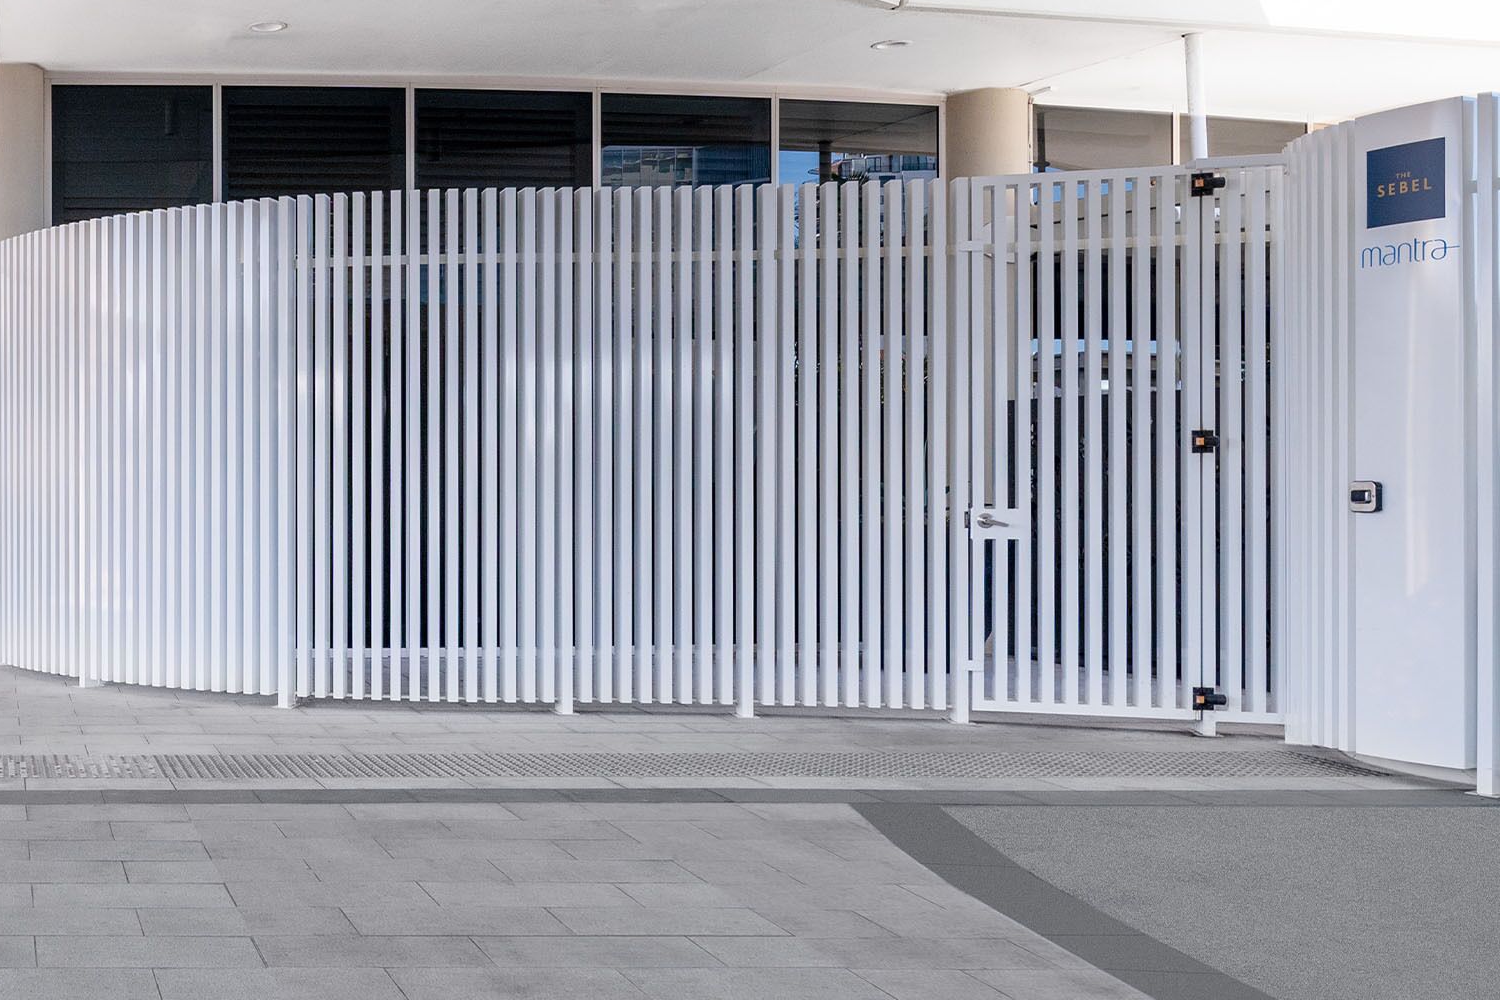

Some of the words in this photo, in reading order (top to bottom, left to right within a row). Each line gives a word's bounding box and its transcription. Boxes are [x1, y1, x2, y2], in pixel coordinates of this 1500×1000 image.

[1395, 171, 1412, 179] THE
[1377, 178, 1433, 198] SEBEL
[1361, 237, 1461, 269] mantra
